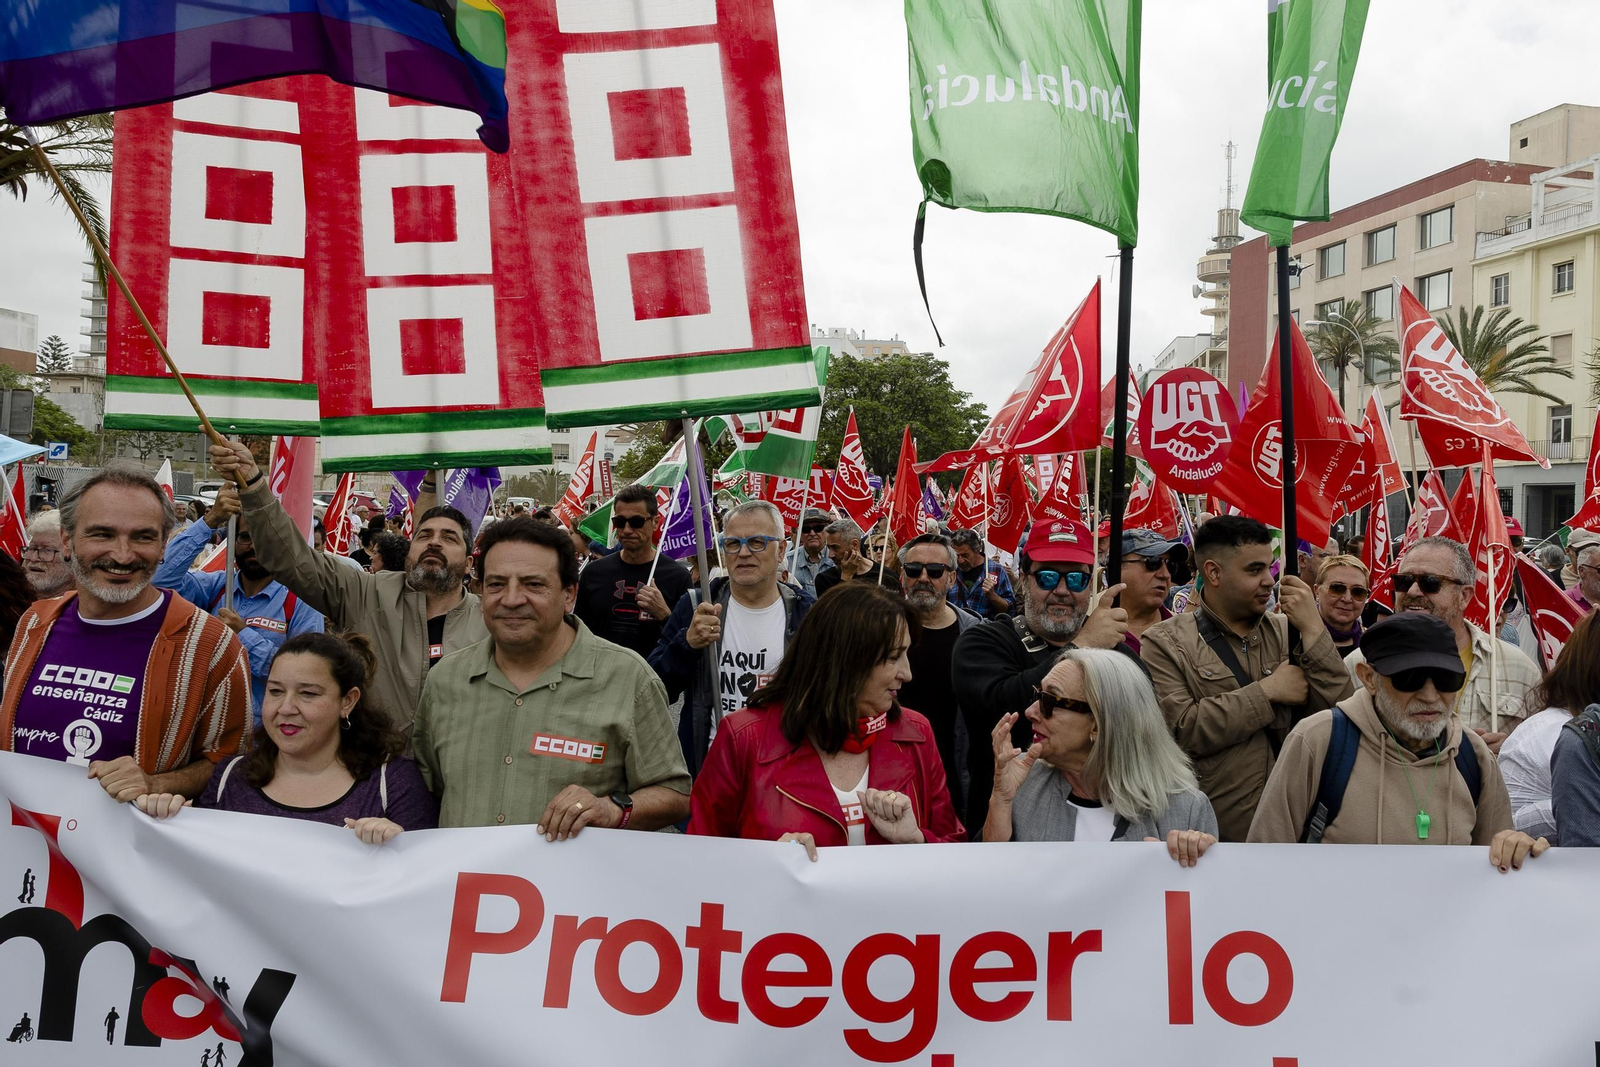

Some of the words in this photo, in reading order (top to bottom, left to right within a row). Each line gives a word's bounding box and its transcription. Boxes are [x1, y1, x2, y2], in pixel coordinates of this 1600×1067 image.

[1151, 381, 1224, 429] UGT
[1169, 461, 1224, 480] Andalucía
[246, 617, 279, 629] CCOO
[721, 648, 767, 671] AQUÍ
[39, 664, 115, 690] CCOO
[32, 685, 128, 709] enseñanza
[721, 698, 737, 712] SE
[83, 706, 124, 723] Cádiz
[534, 736, 593, 758] CCOO
[440, 872, 1102, 1062] Proteger
[1165, 891, 1294, 1027] lo
